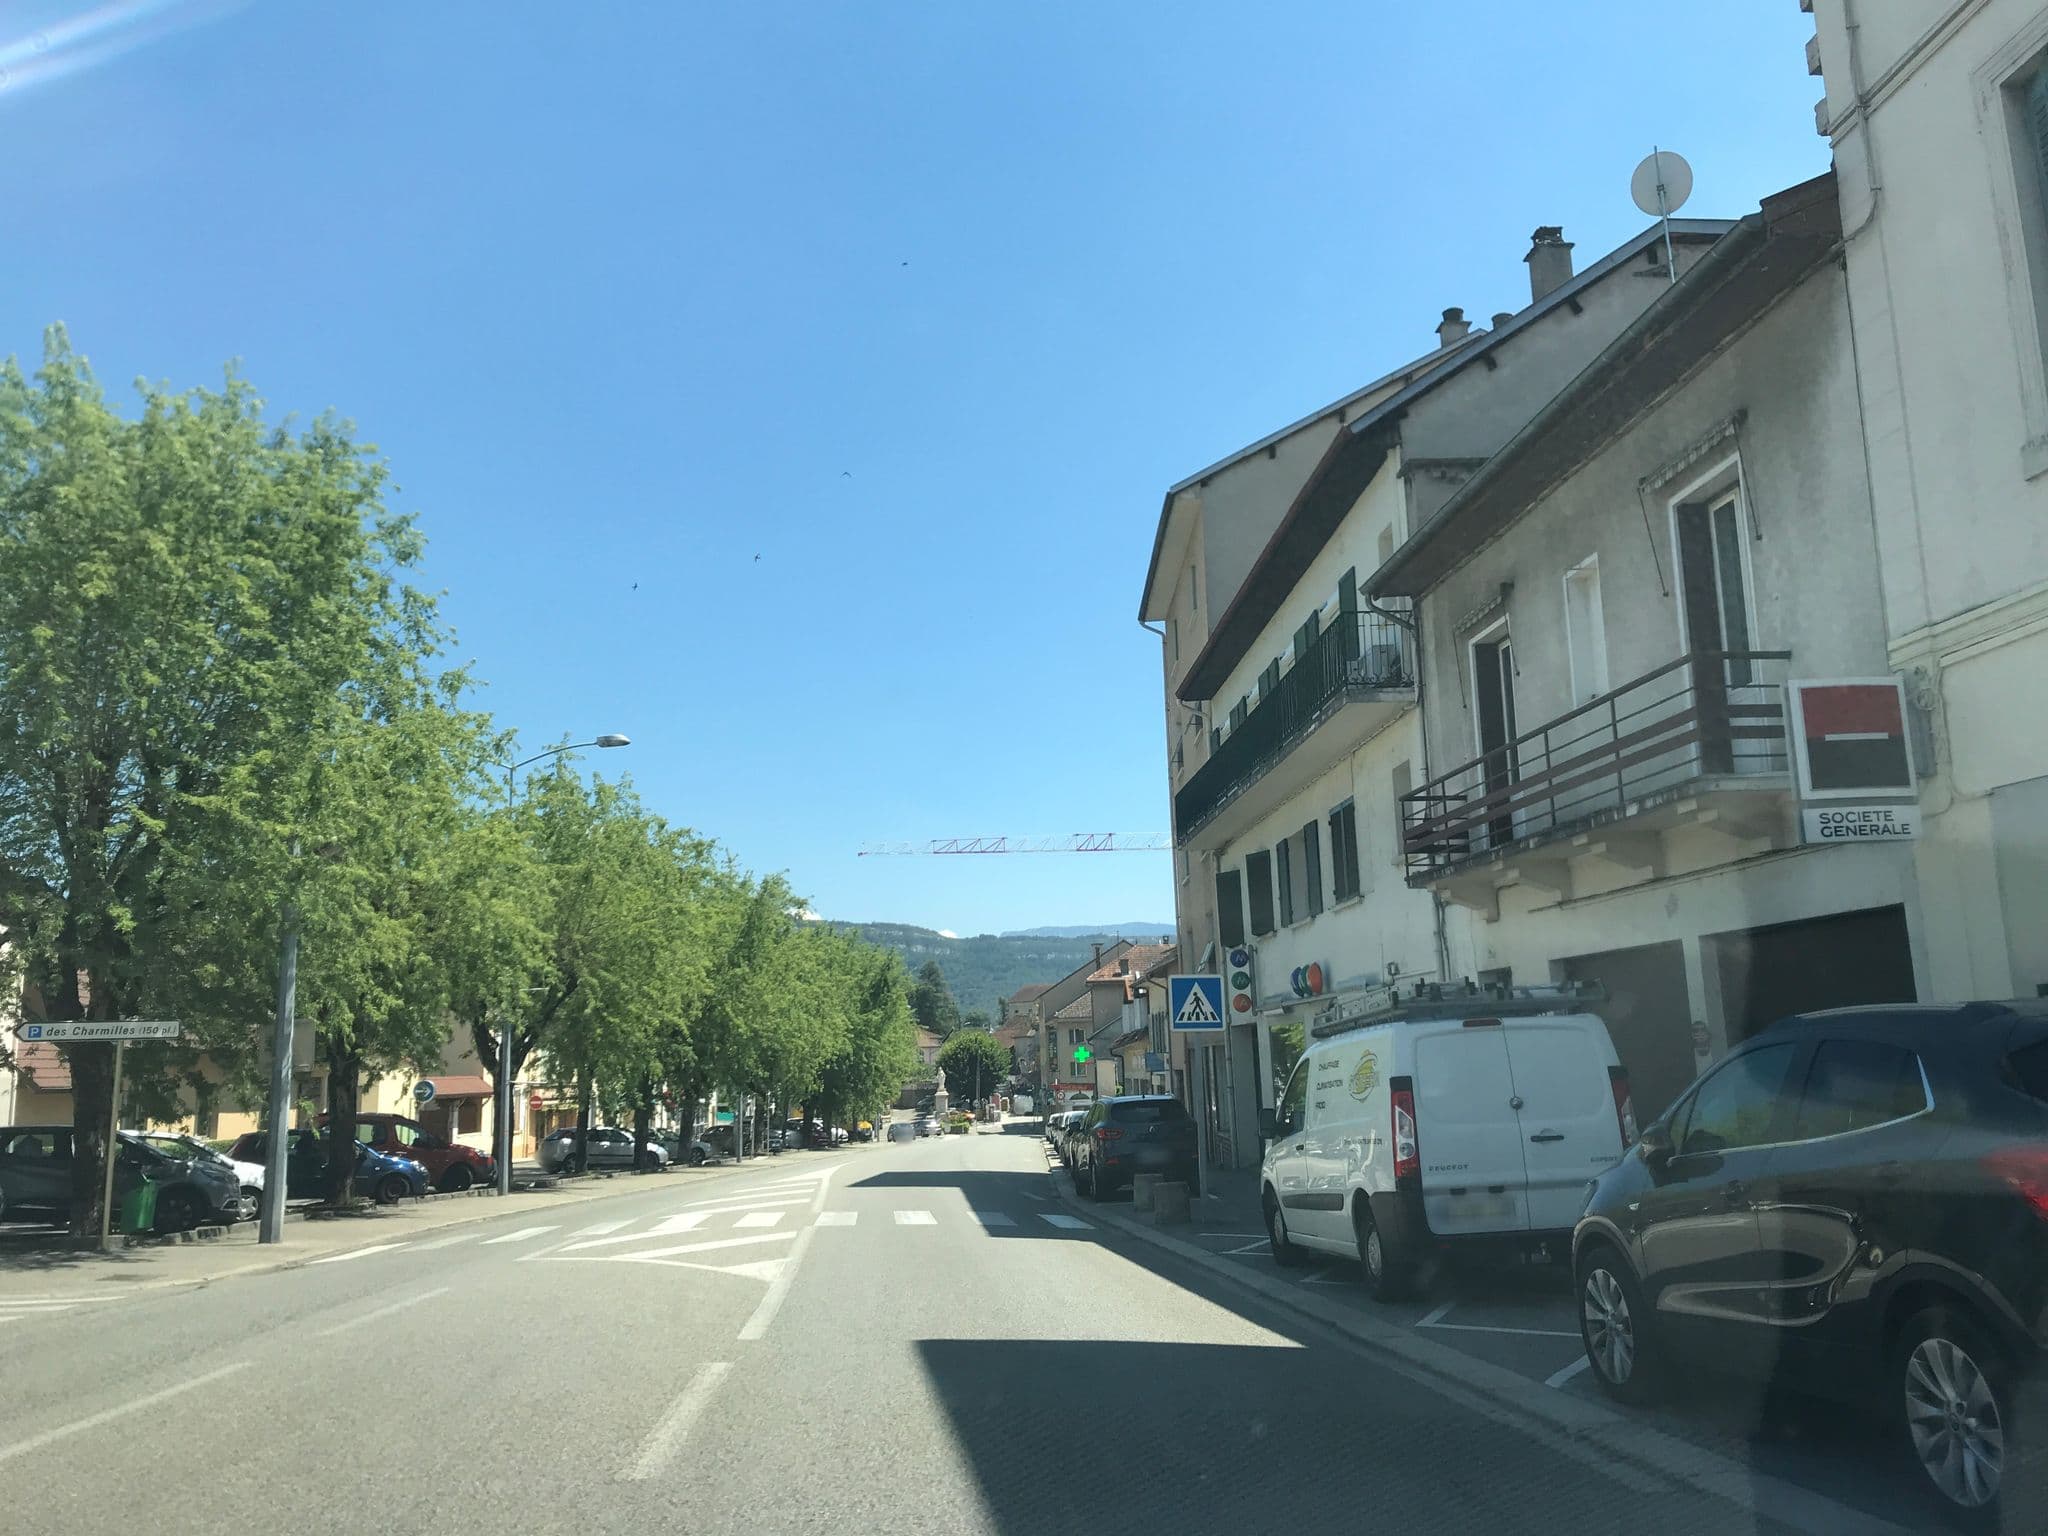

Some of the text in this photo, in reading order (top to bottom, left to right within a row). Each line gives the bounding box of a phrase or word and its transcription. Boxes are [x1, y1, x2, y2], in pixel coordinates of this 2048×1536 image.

[1819, 810, 1894, 824] SOCIETE
[1820, 823, 1911, 838] GENERALE
[46, 1027, 66, 1036] des
[72, 1025, 135, 1036] Charmilles
